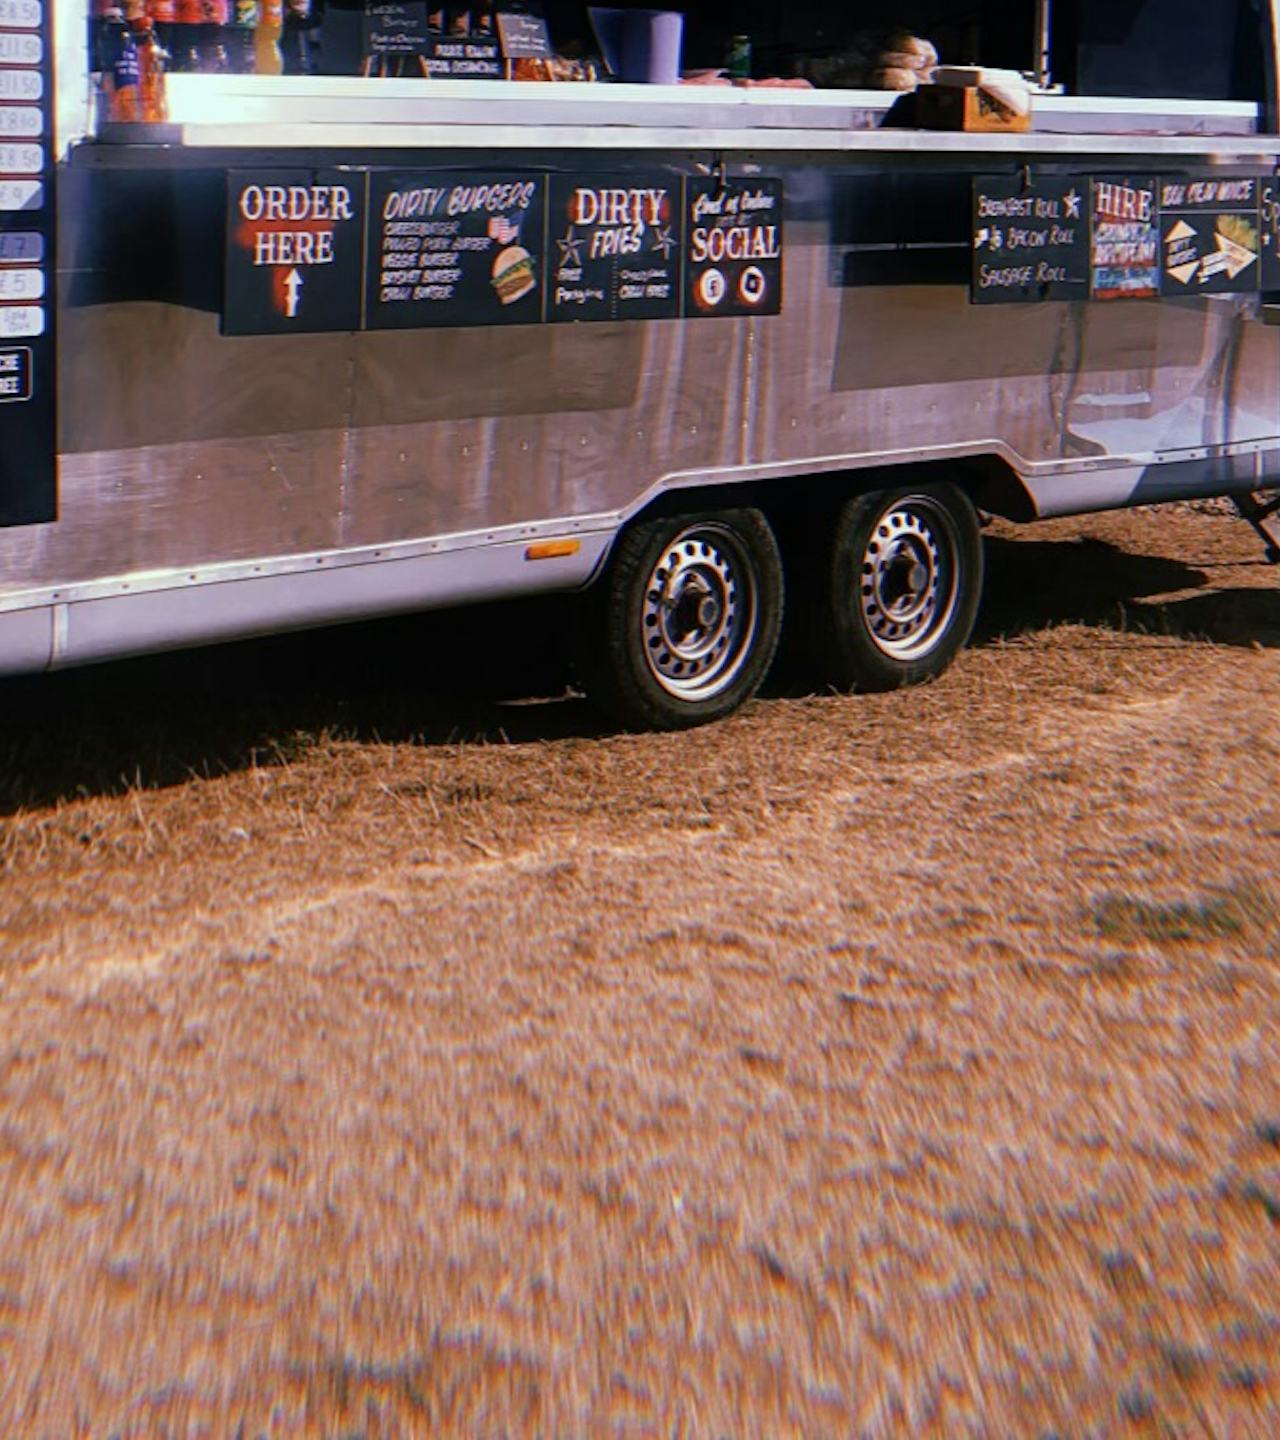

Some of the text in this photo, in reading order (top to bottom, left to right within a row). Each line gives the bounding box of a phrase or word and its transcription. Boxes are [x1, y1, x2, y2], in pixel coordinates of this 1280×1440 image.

[240, 185, 354, 220] ORDER
[383, 181, 535, 220] DIRTY BURGERS
[575, 188, 667, 225] DIRTY
[1095, 181, 1153, 222] HIRE
[253, 231, 334, 266] HERE
[589, 222, 645, 259] FRIES
[692, 226, 780, 262] SOCIAL
